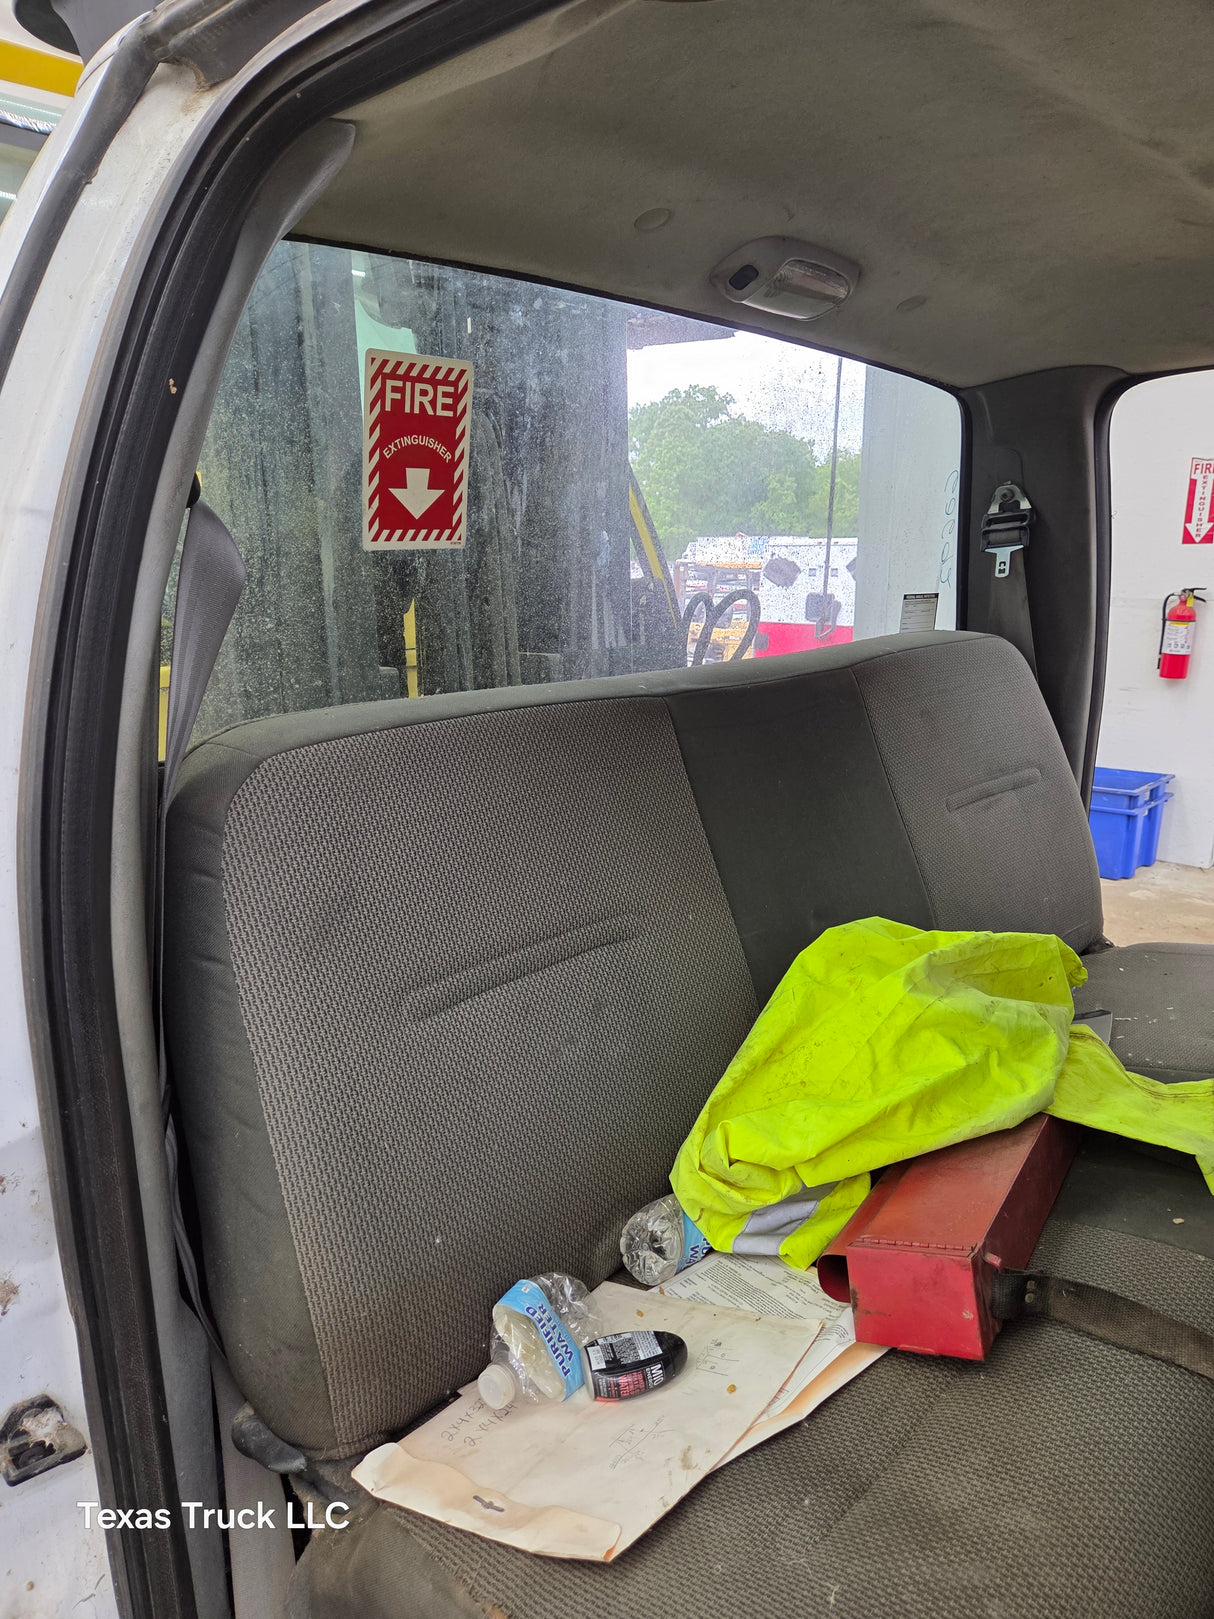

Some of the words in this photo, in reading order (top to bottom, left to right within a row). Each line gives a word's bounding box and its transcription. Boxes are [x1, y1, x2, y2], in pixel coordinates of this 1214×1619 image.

[385, 378, 455, 417] FIRE
[382, 434, 453, 464] EXTINGUISHER
[1194, 475, 1209, 538] EXTINGUISHER
[525, 1305, 571, 1377] PURIFIED
[538, 1303, 574, 1362] WATER
